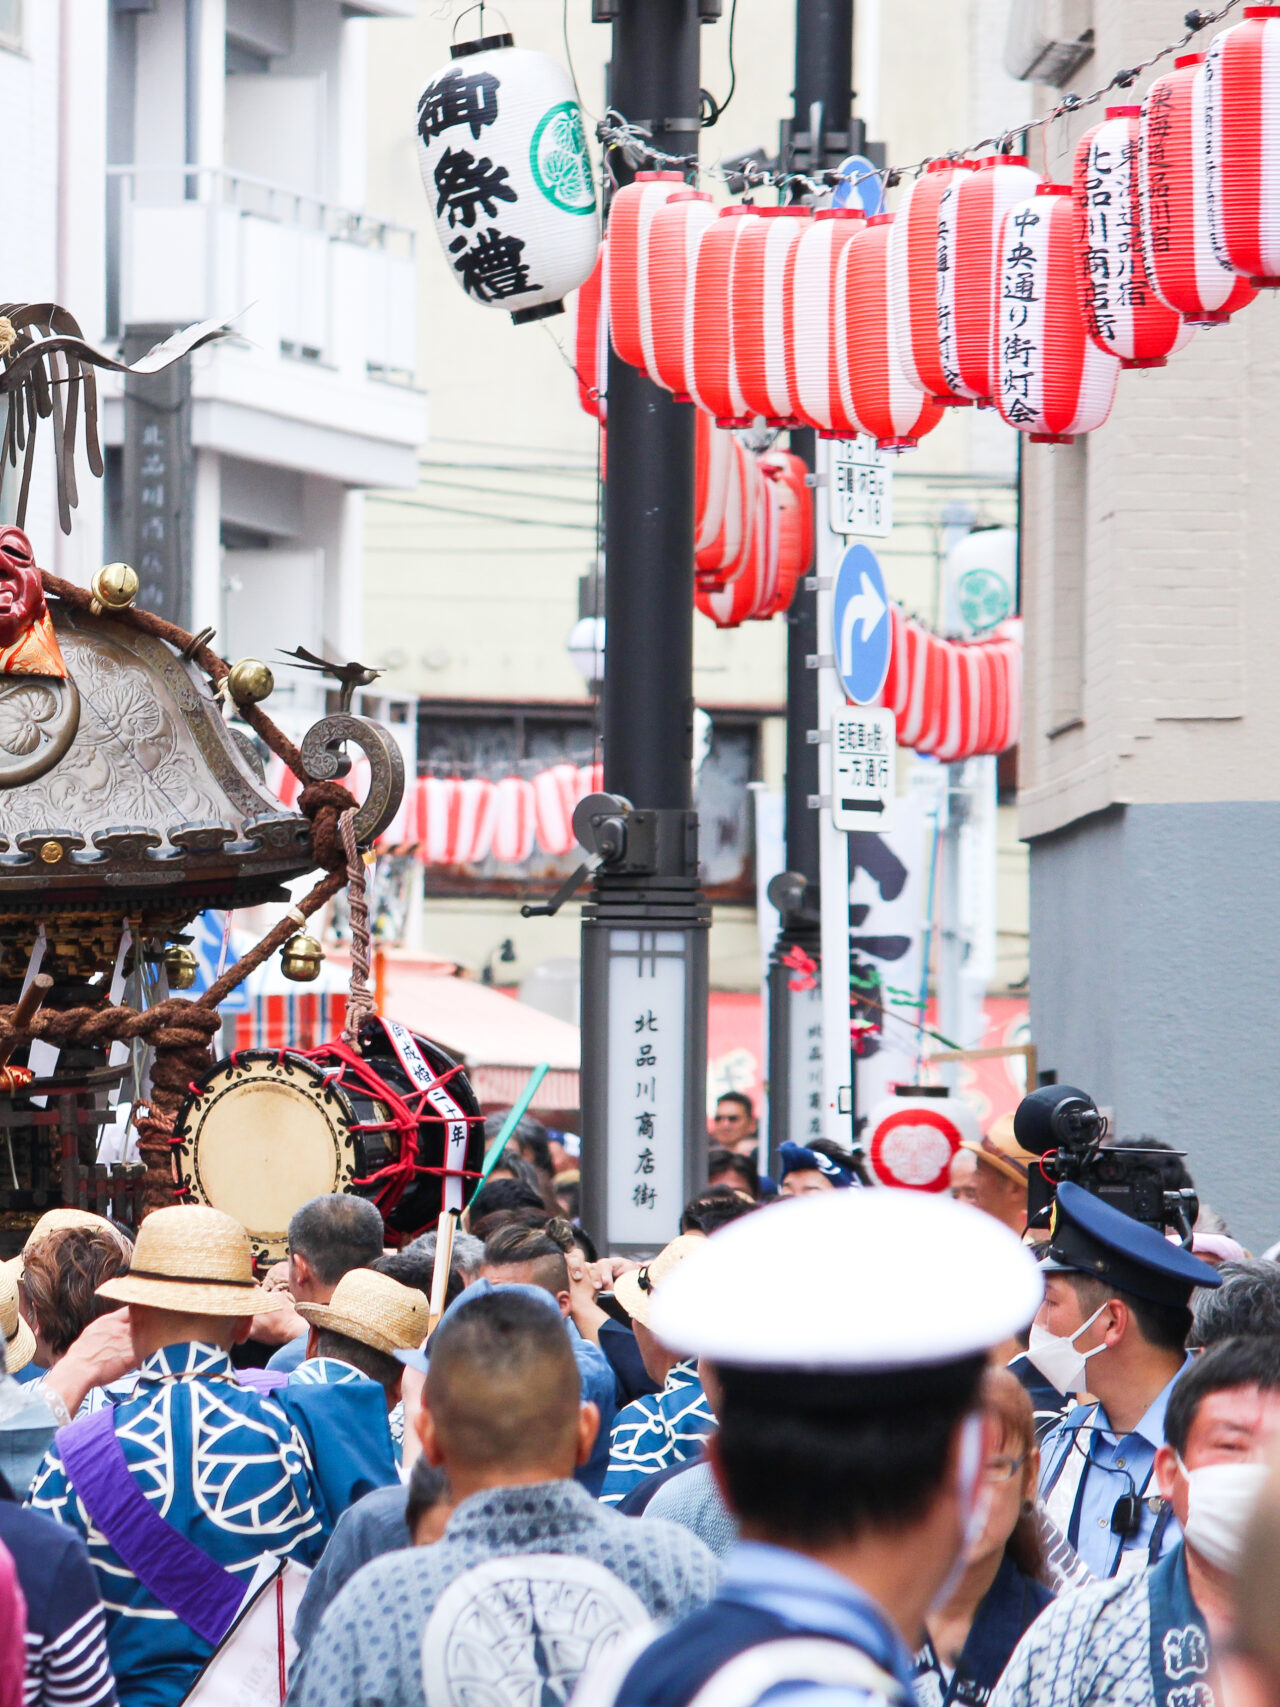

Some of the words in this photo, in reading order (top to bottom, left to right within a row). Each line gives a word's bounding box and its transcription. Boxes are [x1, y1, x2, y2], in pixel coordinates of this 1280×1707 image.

[417, 66, 544, 303] 御祭禮
[1003, 208, 1042, 424] 中央通り街灯会
[633, 1009, 659, 1210] 北品川商店街
